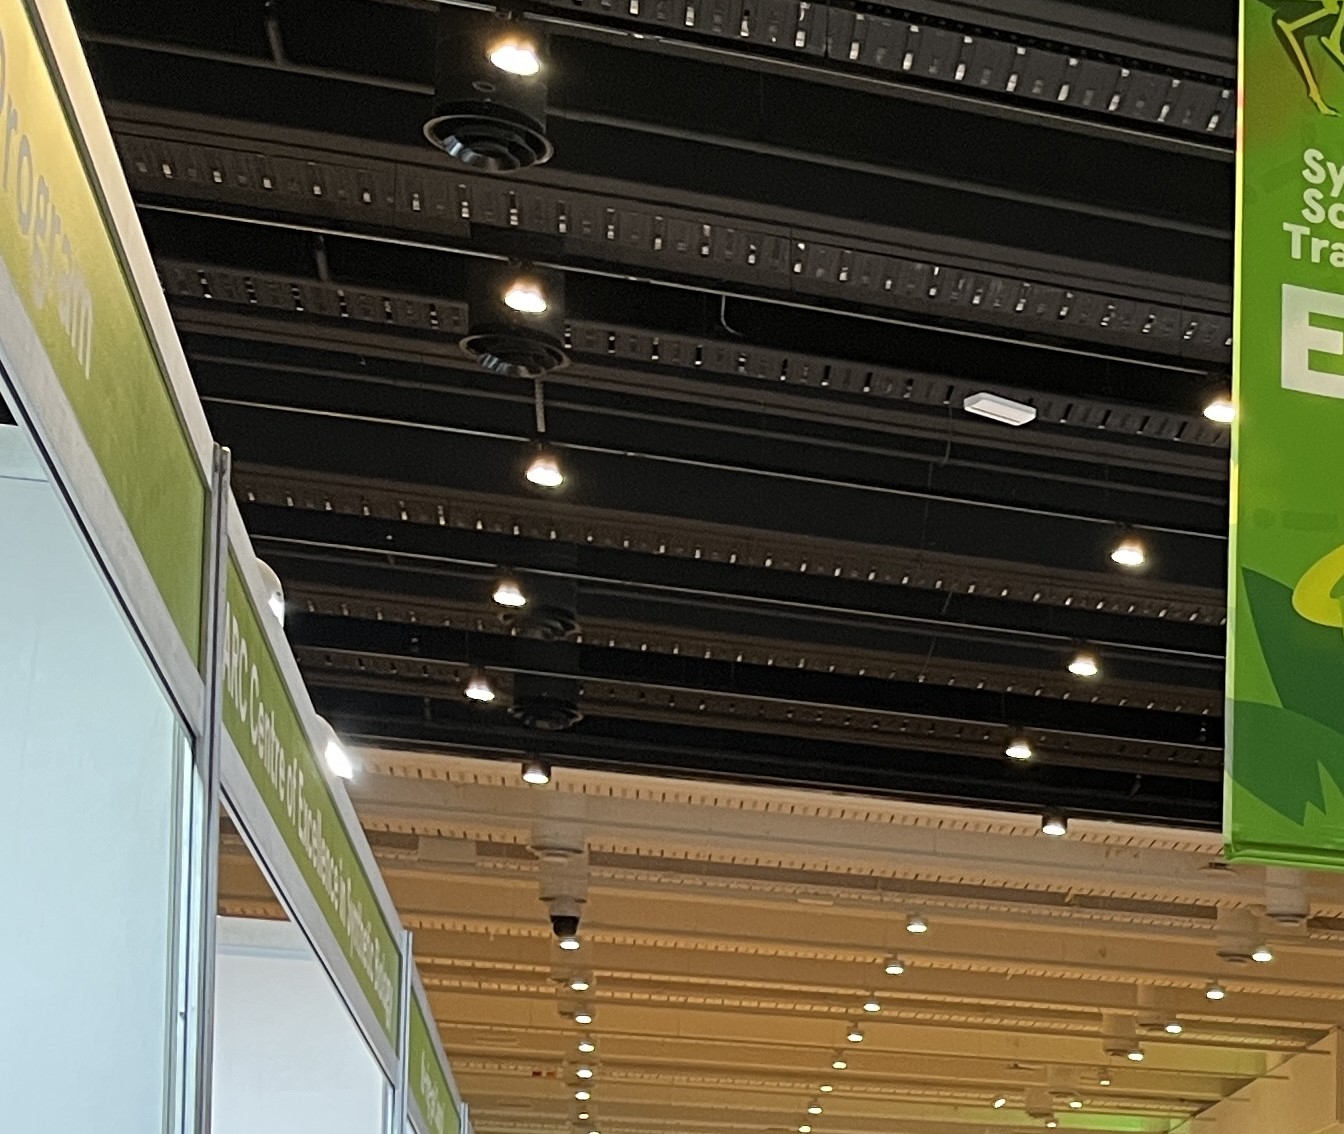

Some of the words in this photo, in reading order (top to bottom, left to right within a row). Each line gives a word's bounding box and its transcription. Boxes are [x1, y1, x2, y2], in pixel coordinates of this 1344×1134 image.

[222, 601, 248, 722] ARC
[250, 664, 286, 802] Centre
[286, 757, 298, 826] of
